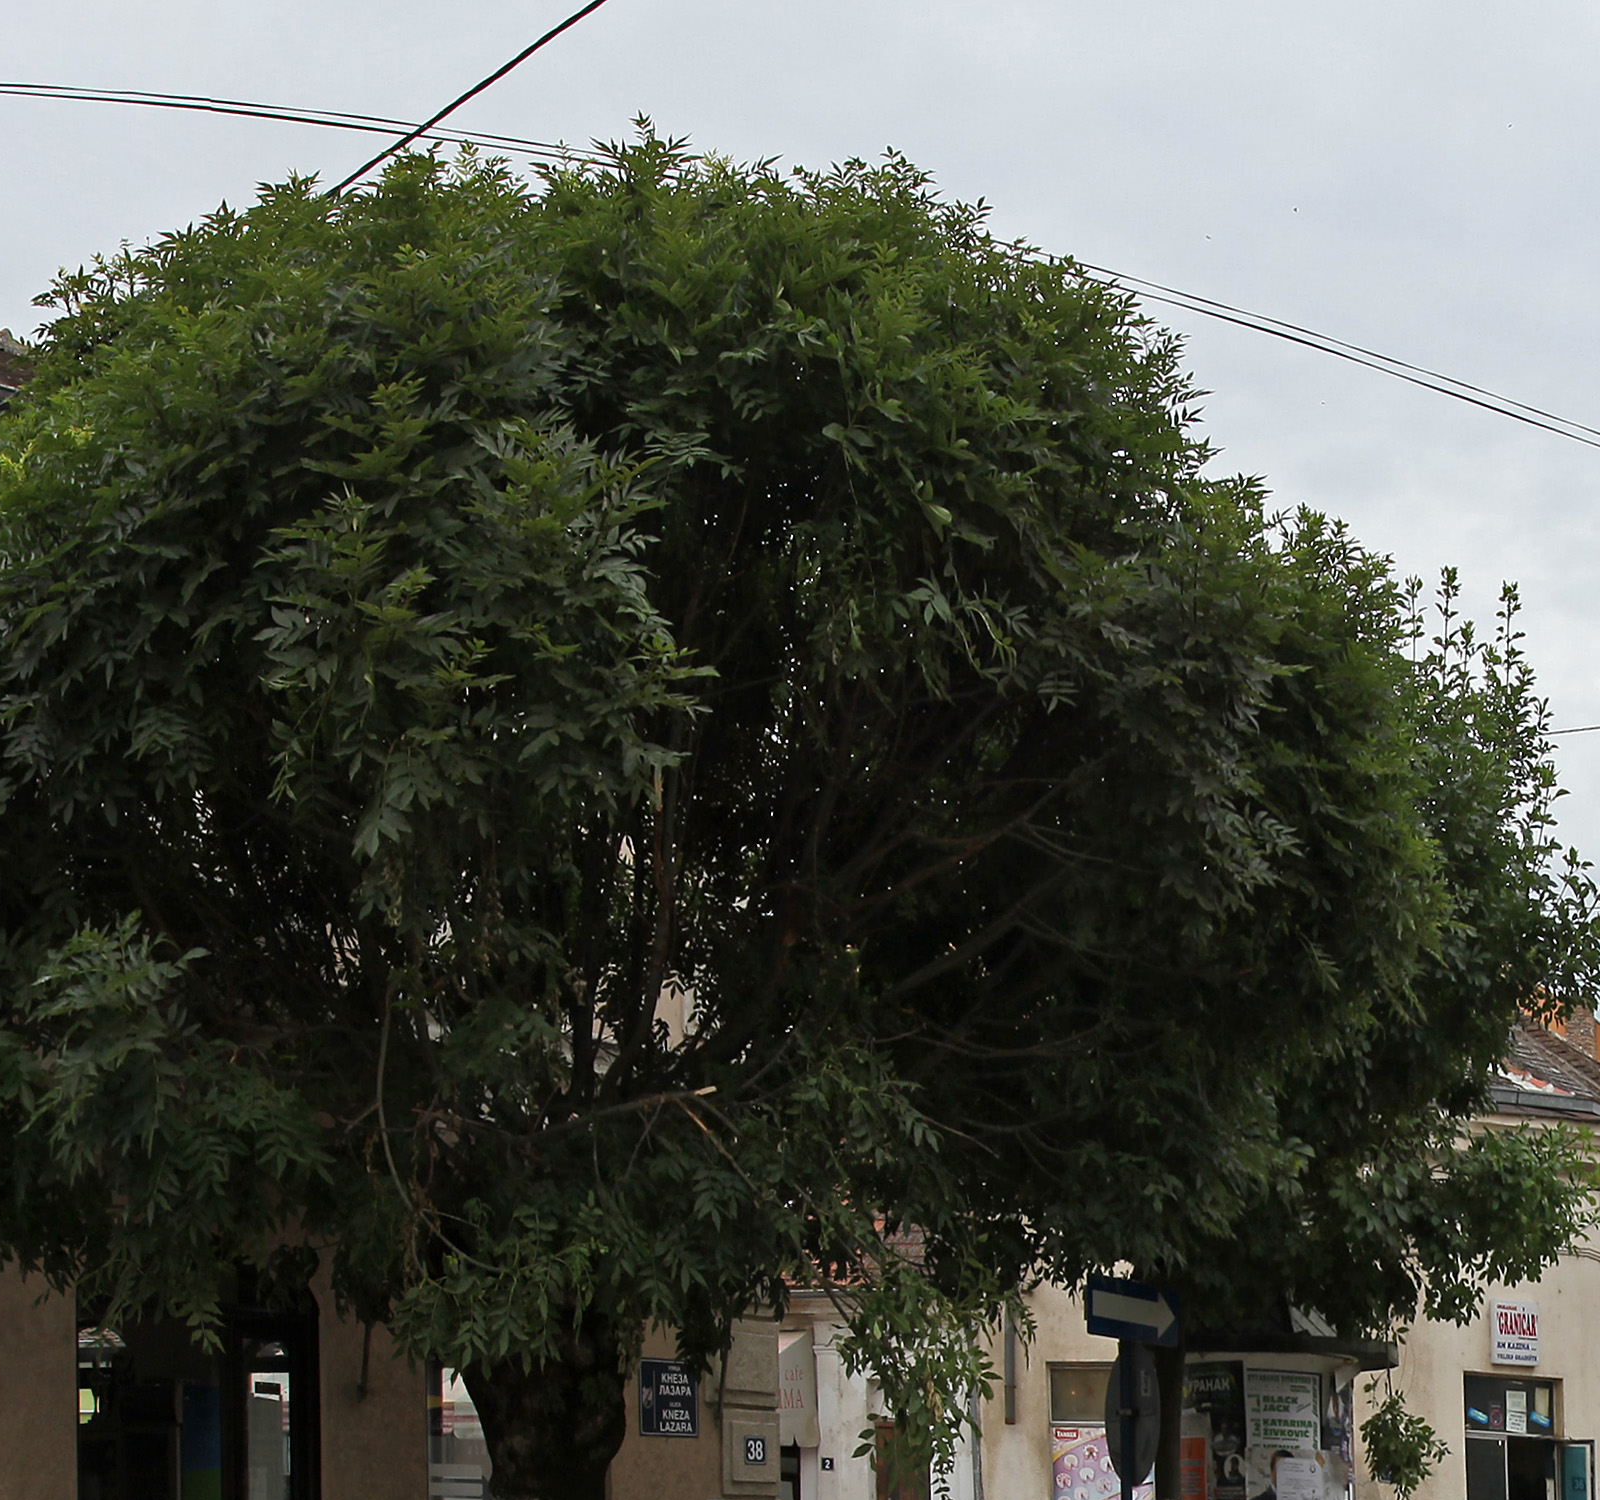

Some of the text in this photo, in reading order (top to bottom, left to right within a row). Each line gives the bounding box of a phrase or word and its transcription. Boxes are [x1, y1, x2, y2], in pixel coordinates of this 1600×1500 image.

[661, 1373, 689, 1384] КНЕЗА
[784, 1367, 803, 1382] cafe
[659, 1385, 692, 1397] ЛАЗАРА
[1262, 1395, 1298, 1404] BLACK
[1262, 1404, 1291, 1413] JACK
[662, 1409, 690, 1420] KNEZA
[659, 1421, 693, 1433] LAZARA
[1262, 1418, 1313, 1428] KATARINA
[747, 1440, 764, 1460] 38
[824, 1459, 831, 1469] 2
